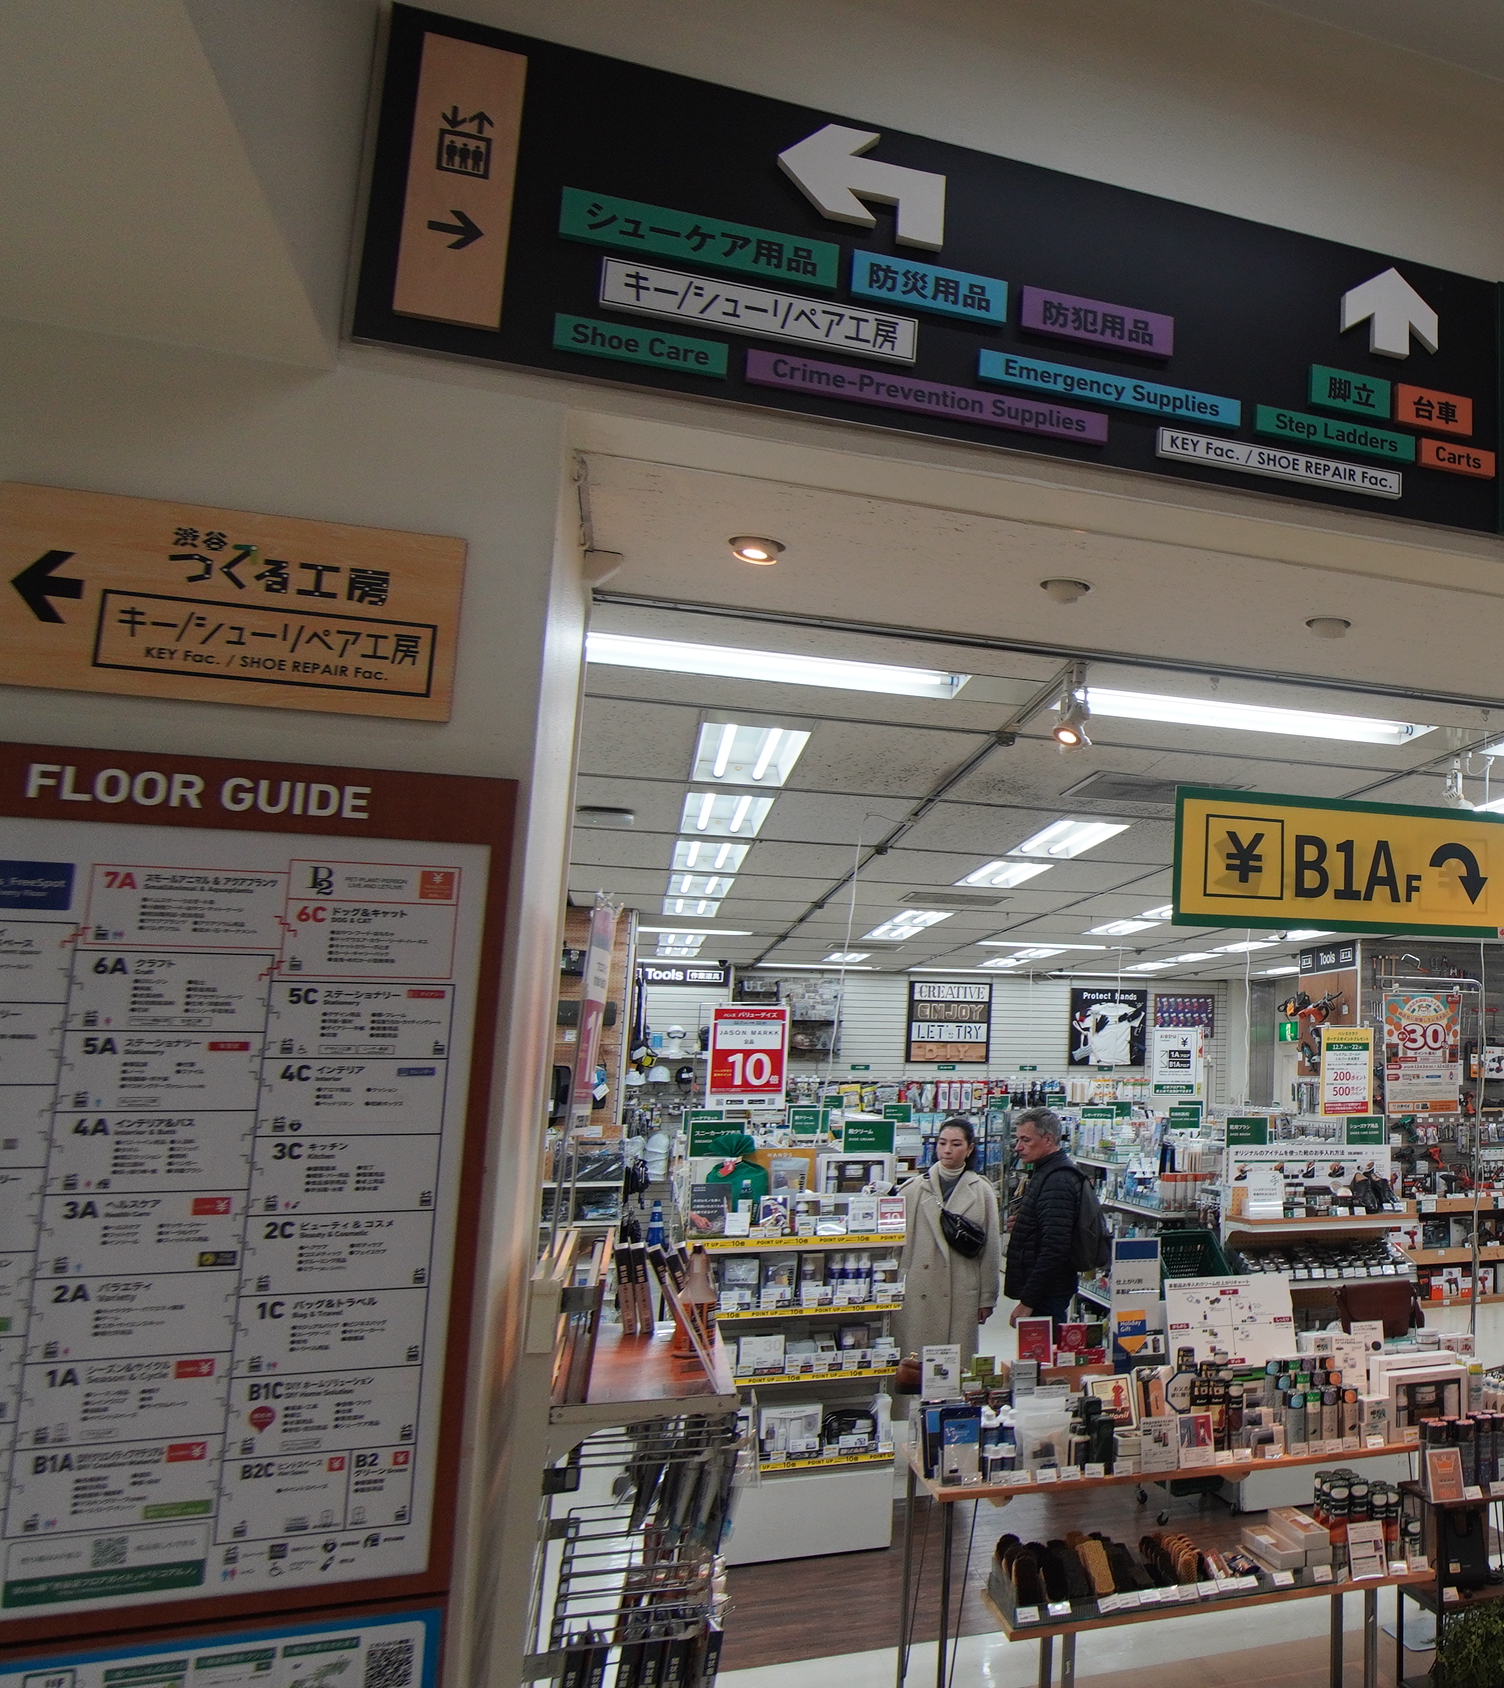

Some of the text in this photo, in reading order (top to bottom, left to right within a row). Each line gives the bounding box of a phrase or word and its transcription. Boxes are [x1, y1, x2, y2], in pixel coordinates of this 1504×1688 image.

[586, 202, 817, 277] シューケア用品
[868, 262, 991, 312] 防災用品
[624, 271, 900, 353] キー/シューリペア工房
[1042, 300, 1154, 346] 防犯用品
[572, 323, 710, 365] Shoe Care
[773, 359, 1086, 433] Crime-Prevention Supplies
[1004, 358, 1219, 417] Emergency Supplies
[1328, 377, 1375, 409] 脚立
[1413, 395, 1458, 425] 台車
[1275, 414, 1398, 453] Step Ladders
[1170, 435, 1393, 489] KEY Fac. SHOE REPAIR Fac.
[1435, 446, 1482, 470] Carts
[172, 526, 228, 552] 渋谷
[167, 544, 390, 607] つくる工房
[117, 606, 422, 667] キー/シューリペア工房
[144, 645, 388, 682] KEY Fac. SHOE REPAIR Fac.
[24, 762, 372, 820] FLOOR GUIDE
[1225, 830, 1265, 884] ¥
[103, 870, 138, 890] 7A
[296, 905, 328, 923] 6C
[93, 957, 129, 975] 6A
[1319, 953, 1336, 967] Tools
[645, 968, 684, 982] Tools
[288, 987, 319, 1004] 5C
[323, 990, 402, 1000] ステーショナリー
[919, 983, 985, 999] CREATIVE
[1082, 991, 1111, 1000] Protect
[917, 1003, 985, 1021] ENJOY
[954, 1024, 982, 1040] TRY
[83, 1037, 118, 1055] 5A
[1180, 1037, 1189, 1047] ¥
[280, 1064, 312, 1082] 4C
[316, 1065, 366, 1075] インテリア
[72, 1118, 110, 1136] 4A
[272, 1142, 304, 1160] 3C
[307, 1143, 349, 1151] キッチン
[1233, 1149, 1345, 1157] オリジナルのアイテムを使った靴のお手入れ方法
[62, 1200, 100, 1220] 3A
[263, 1221, 296, 1240] 2C
[364, 1219, 395, 1229] コスメ
[52, 1283, 90, 1303] 2A
[256, 1301, 286, 1320] 1C
[1120, 1319, 1142, 1328] Holiday
[46, 1367, 80, 1388] 1A
[249, 1381, 285, 1402] B1C
[32, 1453, 74, 1475] B1A
[355, 1453, 379, 1469] B2
[240, 1462, 276, 1480] B2C
